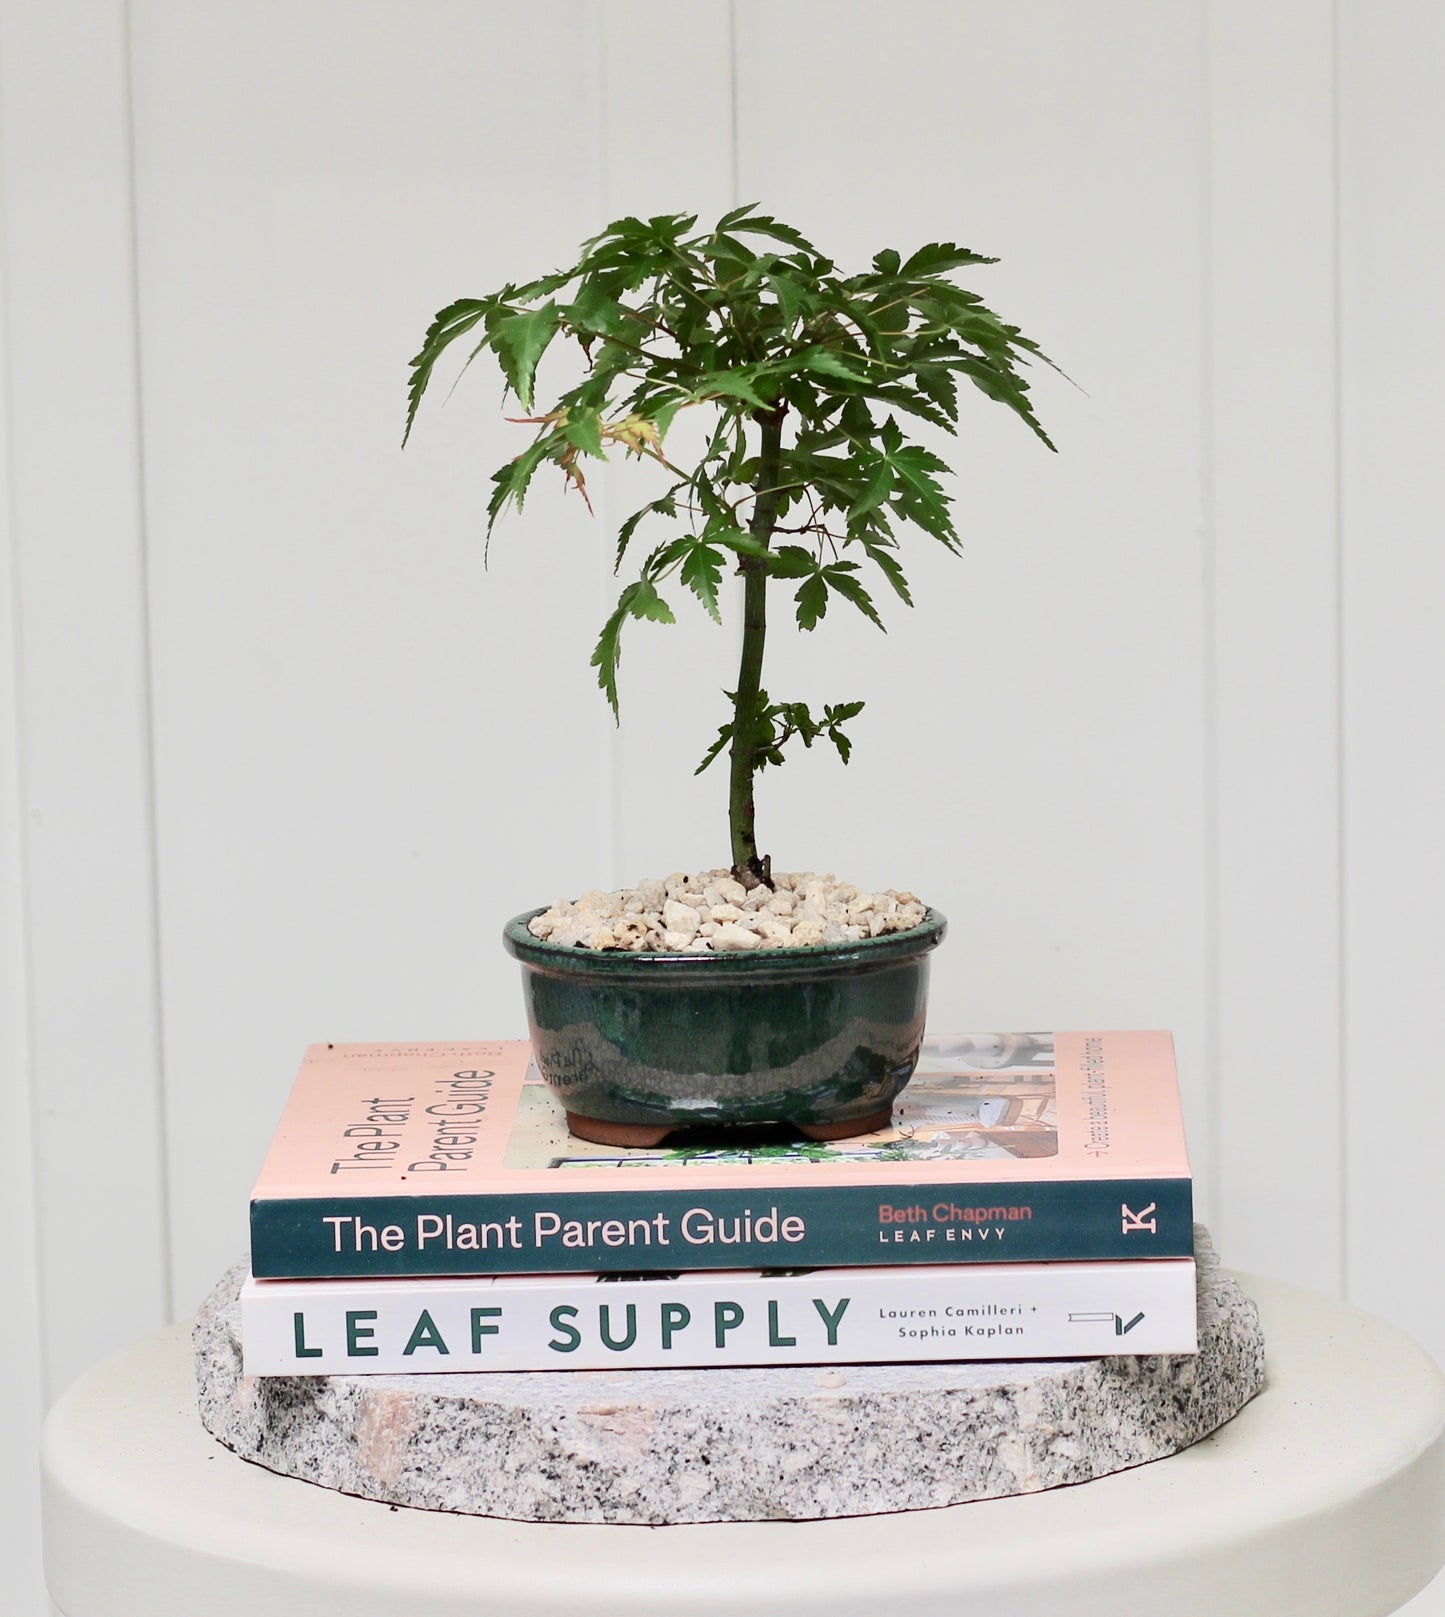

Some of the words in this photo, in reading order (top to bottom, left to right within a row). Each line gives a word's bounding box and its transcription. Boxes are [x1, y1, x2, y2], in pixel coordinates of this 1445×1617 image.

[1080, 1038, 1103, 1055] home
[425, 1070, 495, 1115] Guide
[344, 1097, 414, 1138] Plant
[408, 1119, 482, 1172] Parent
[1083, 1125, 1110, 1149] Create
[331, 1141, 400, 1174] The
[878, 1204, 928, 1223] Beth
[932, 1202, 1033, 1225] Chapman
[322, 1216, 405, 1252] The
[417, 1214, 523, 1250] Plant
[534, 1212, 670, 1248] Parent
[681, 1206, 805, 1245] Guide
[879, 1229, 936, 1243] LEAF
[946, 1227, 1006, 1241] ENVY
[879, 1308, 938, 1319] Lauren
[945, 1304, 1023, 1318] Camilleri
[293, 1307, 503, 1359] LEAF
[547, 1297, 852, 1353] SUPPLY
[898, 1325, 957, 1340] Sophia
[964, 1324, 1025, 1338] Kaplan
